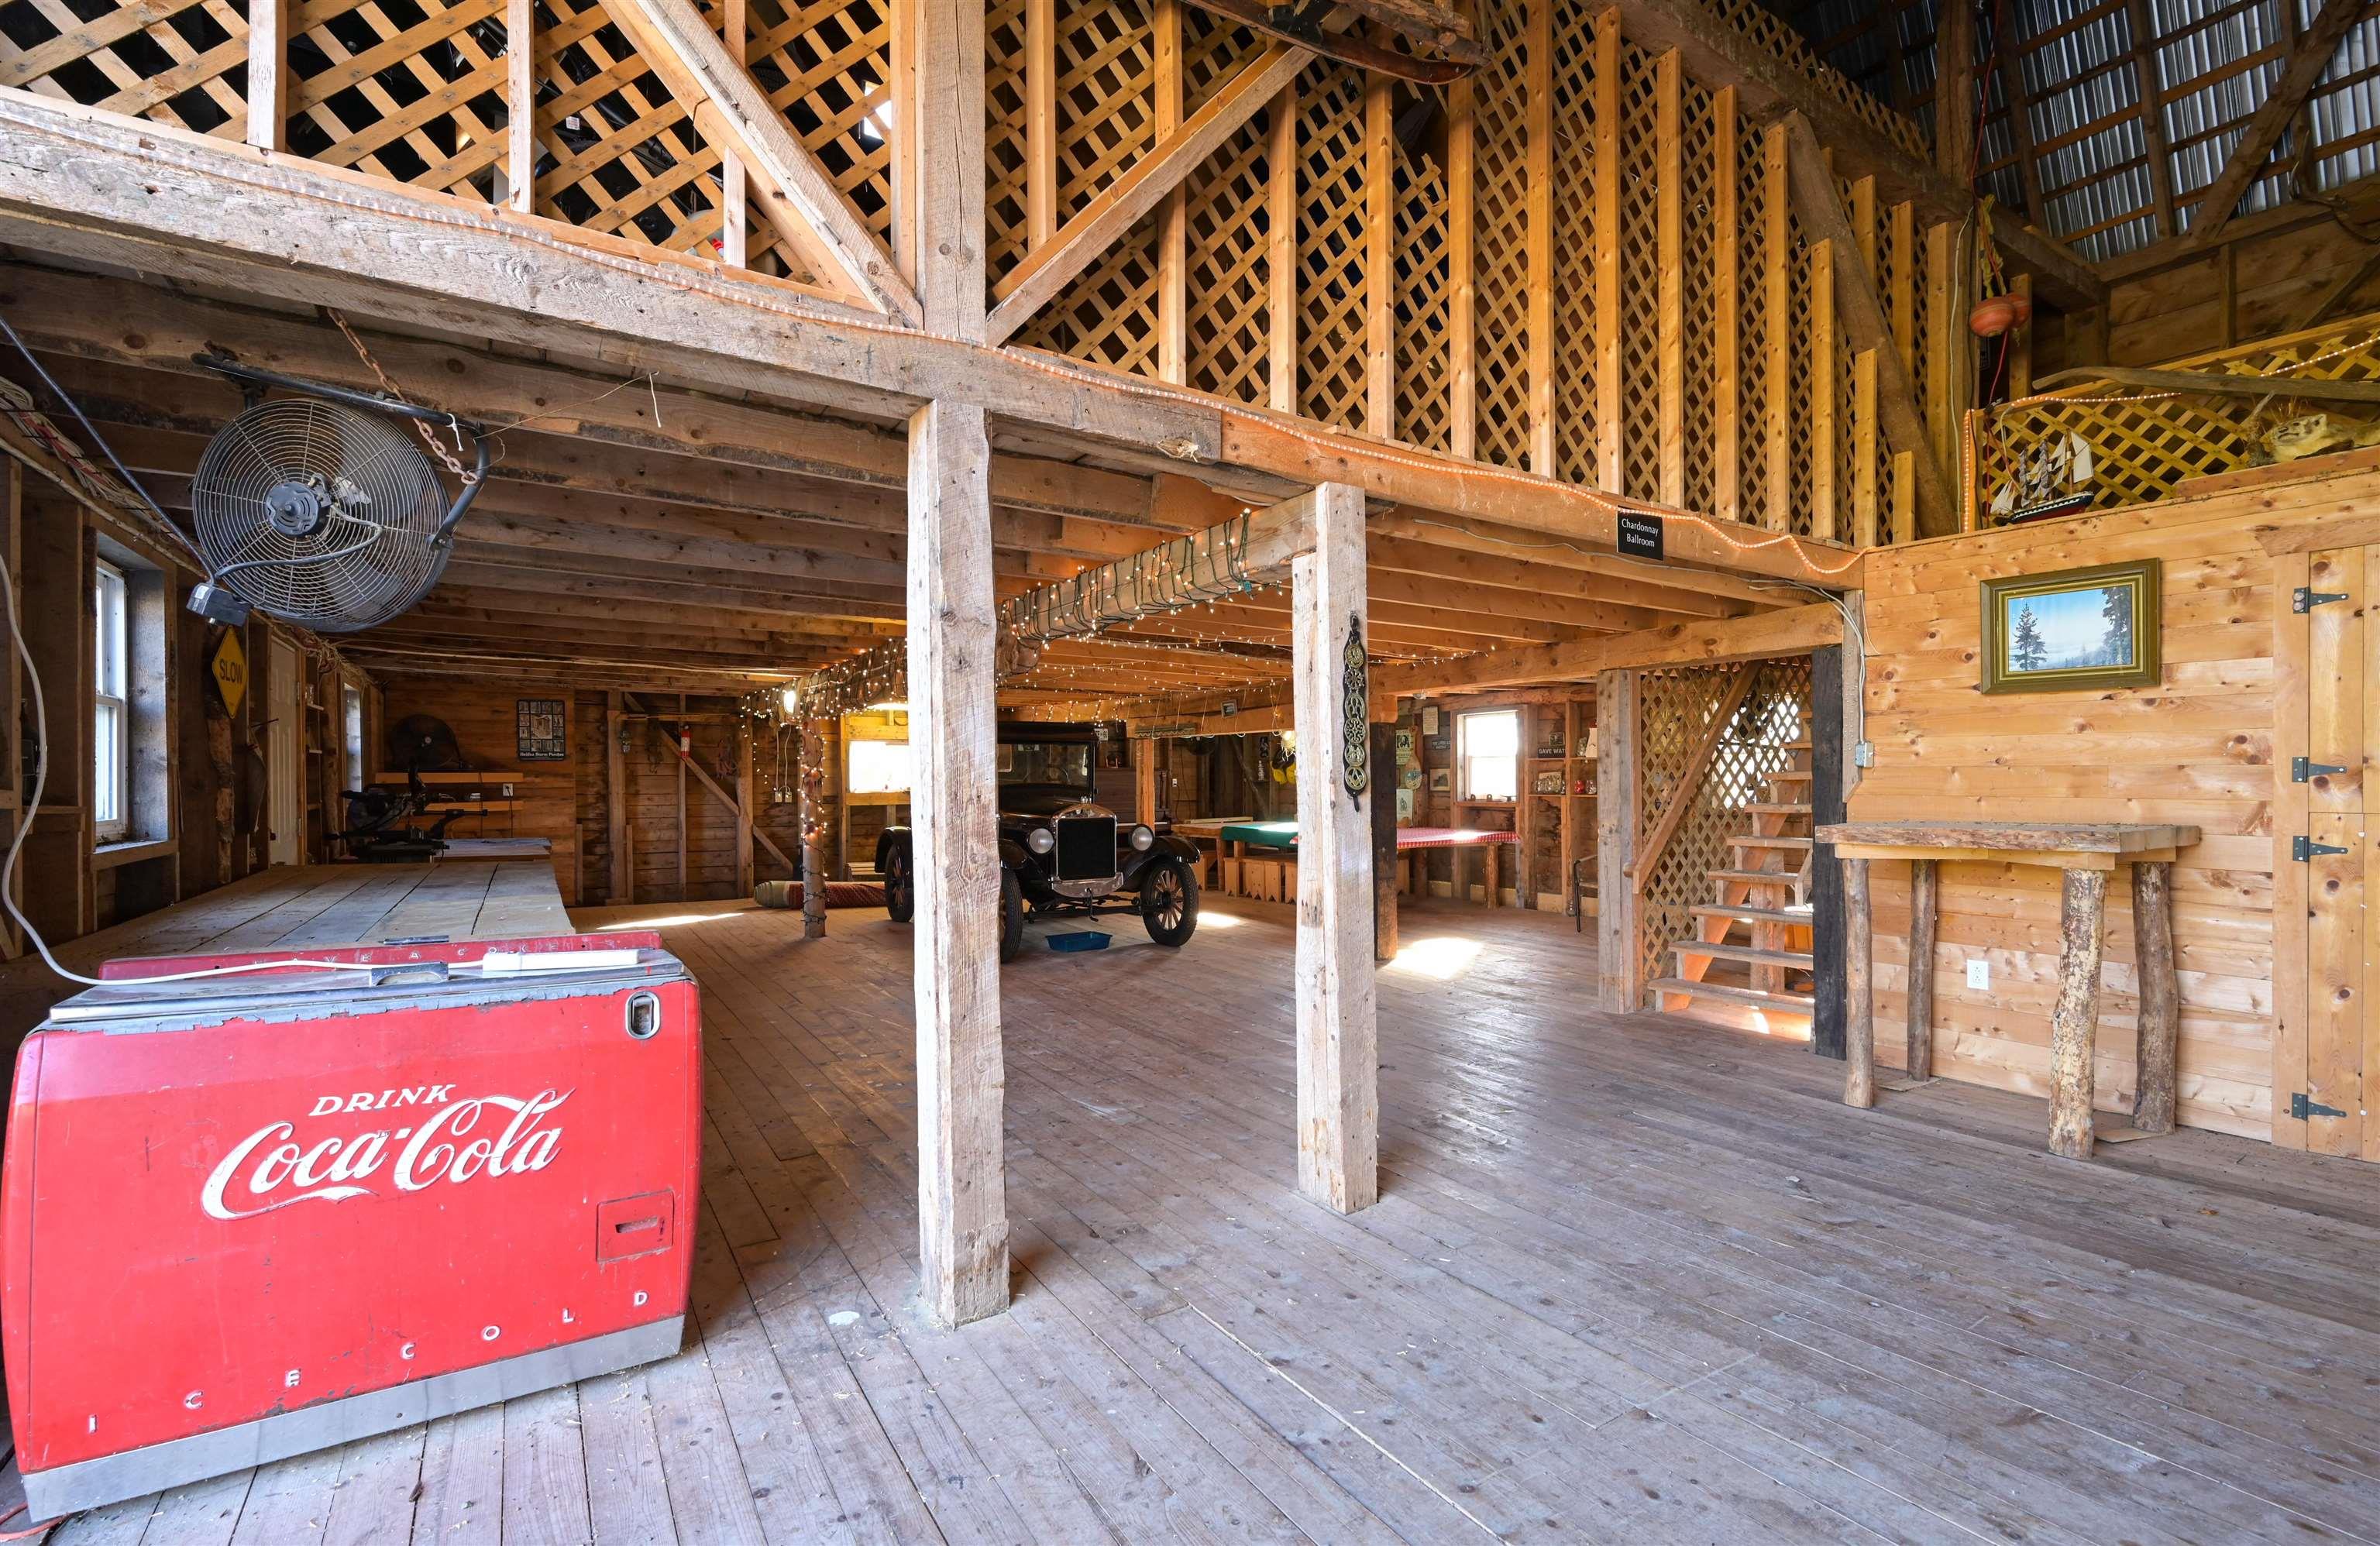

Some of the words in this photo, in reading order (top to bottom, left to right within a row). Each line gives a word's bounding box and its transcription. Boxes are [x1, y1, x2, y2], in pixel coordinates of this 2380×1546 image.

[1622, 518, 1659, 537] Chardonnay
[1627, 533, 1655, 547] Ballroom
[219, 658, 243, 683] SLOW
[309, 1084, 456, 1116] DRINK
[201, 1087, 576, 1221] Coca-Cola
[400, 1290, 648, 1360] COLD
